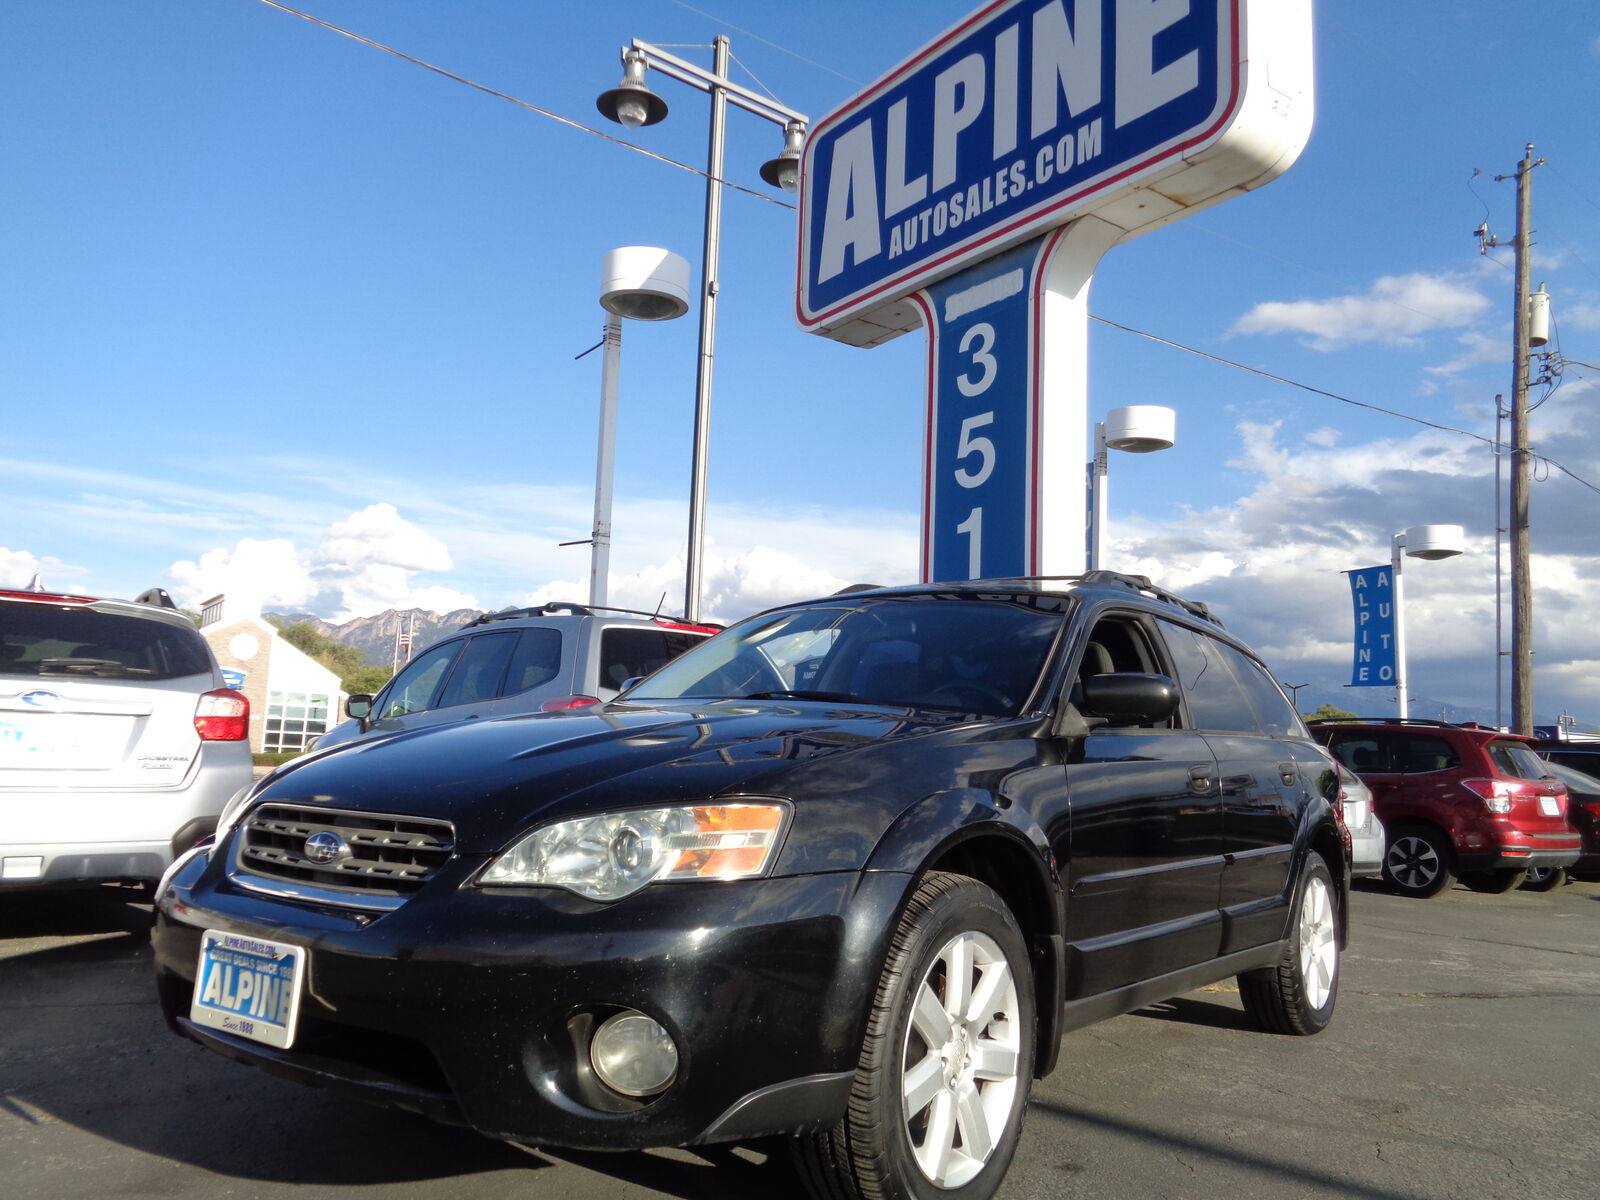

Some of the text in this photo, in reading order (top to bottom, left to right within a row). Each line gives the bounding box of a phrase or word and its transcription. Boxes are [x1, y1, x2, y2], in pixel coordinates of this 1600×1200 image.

[818, 0, 1199, 285] ALPINE
[888, 117, 1102, 260] AUTOSALES.COM
[1355, 574, 1371, 681] ALPINE
[1377, 571, 1393, 681] AUTO
[202, 962, 292, 1022] ALPINE
